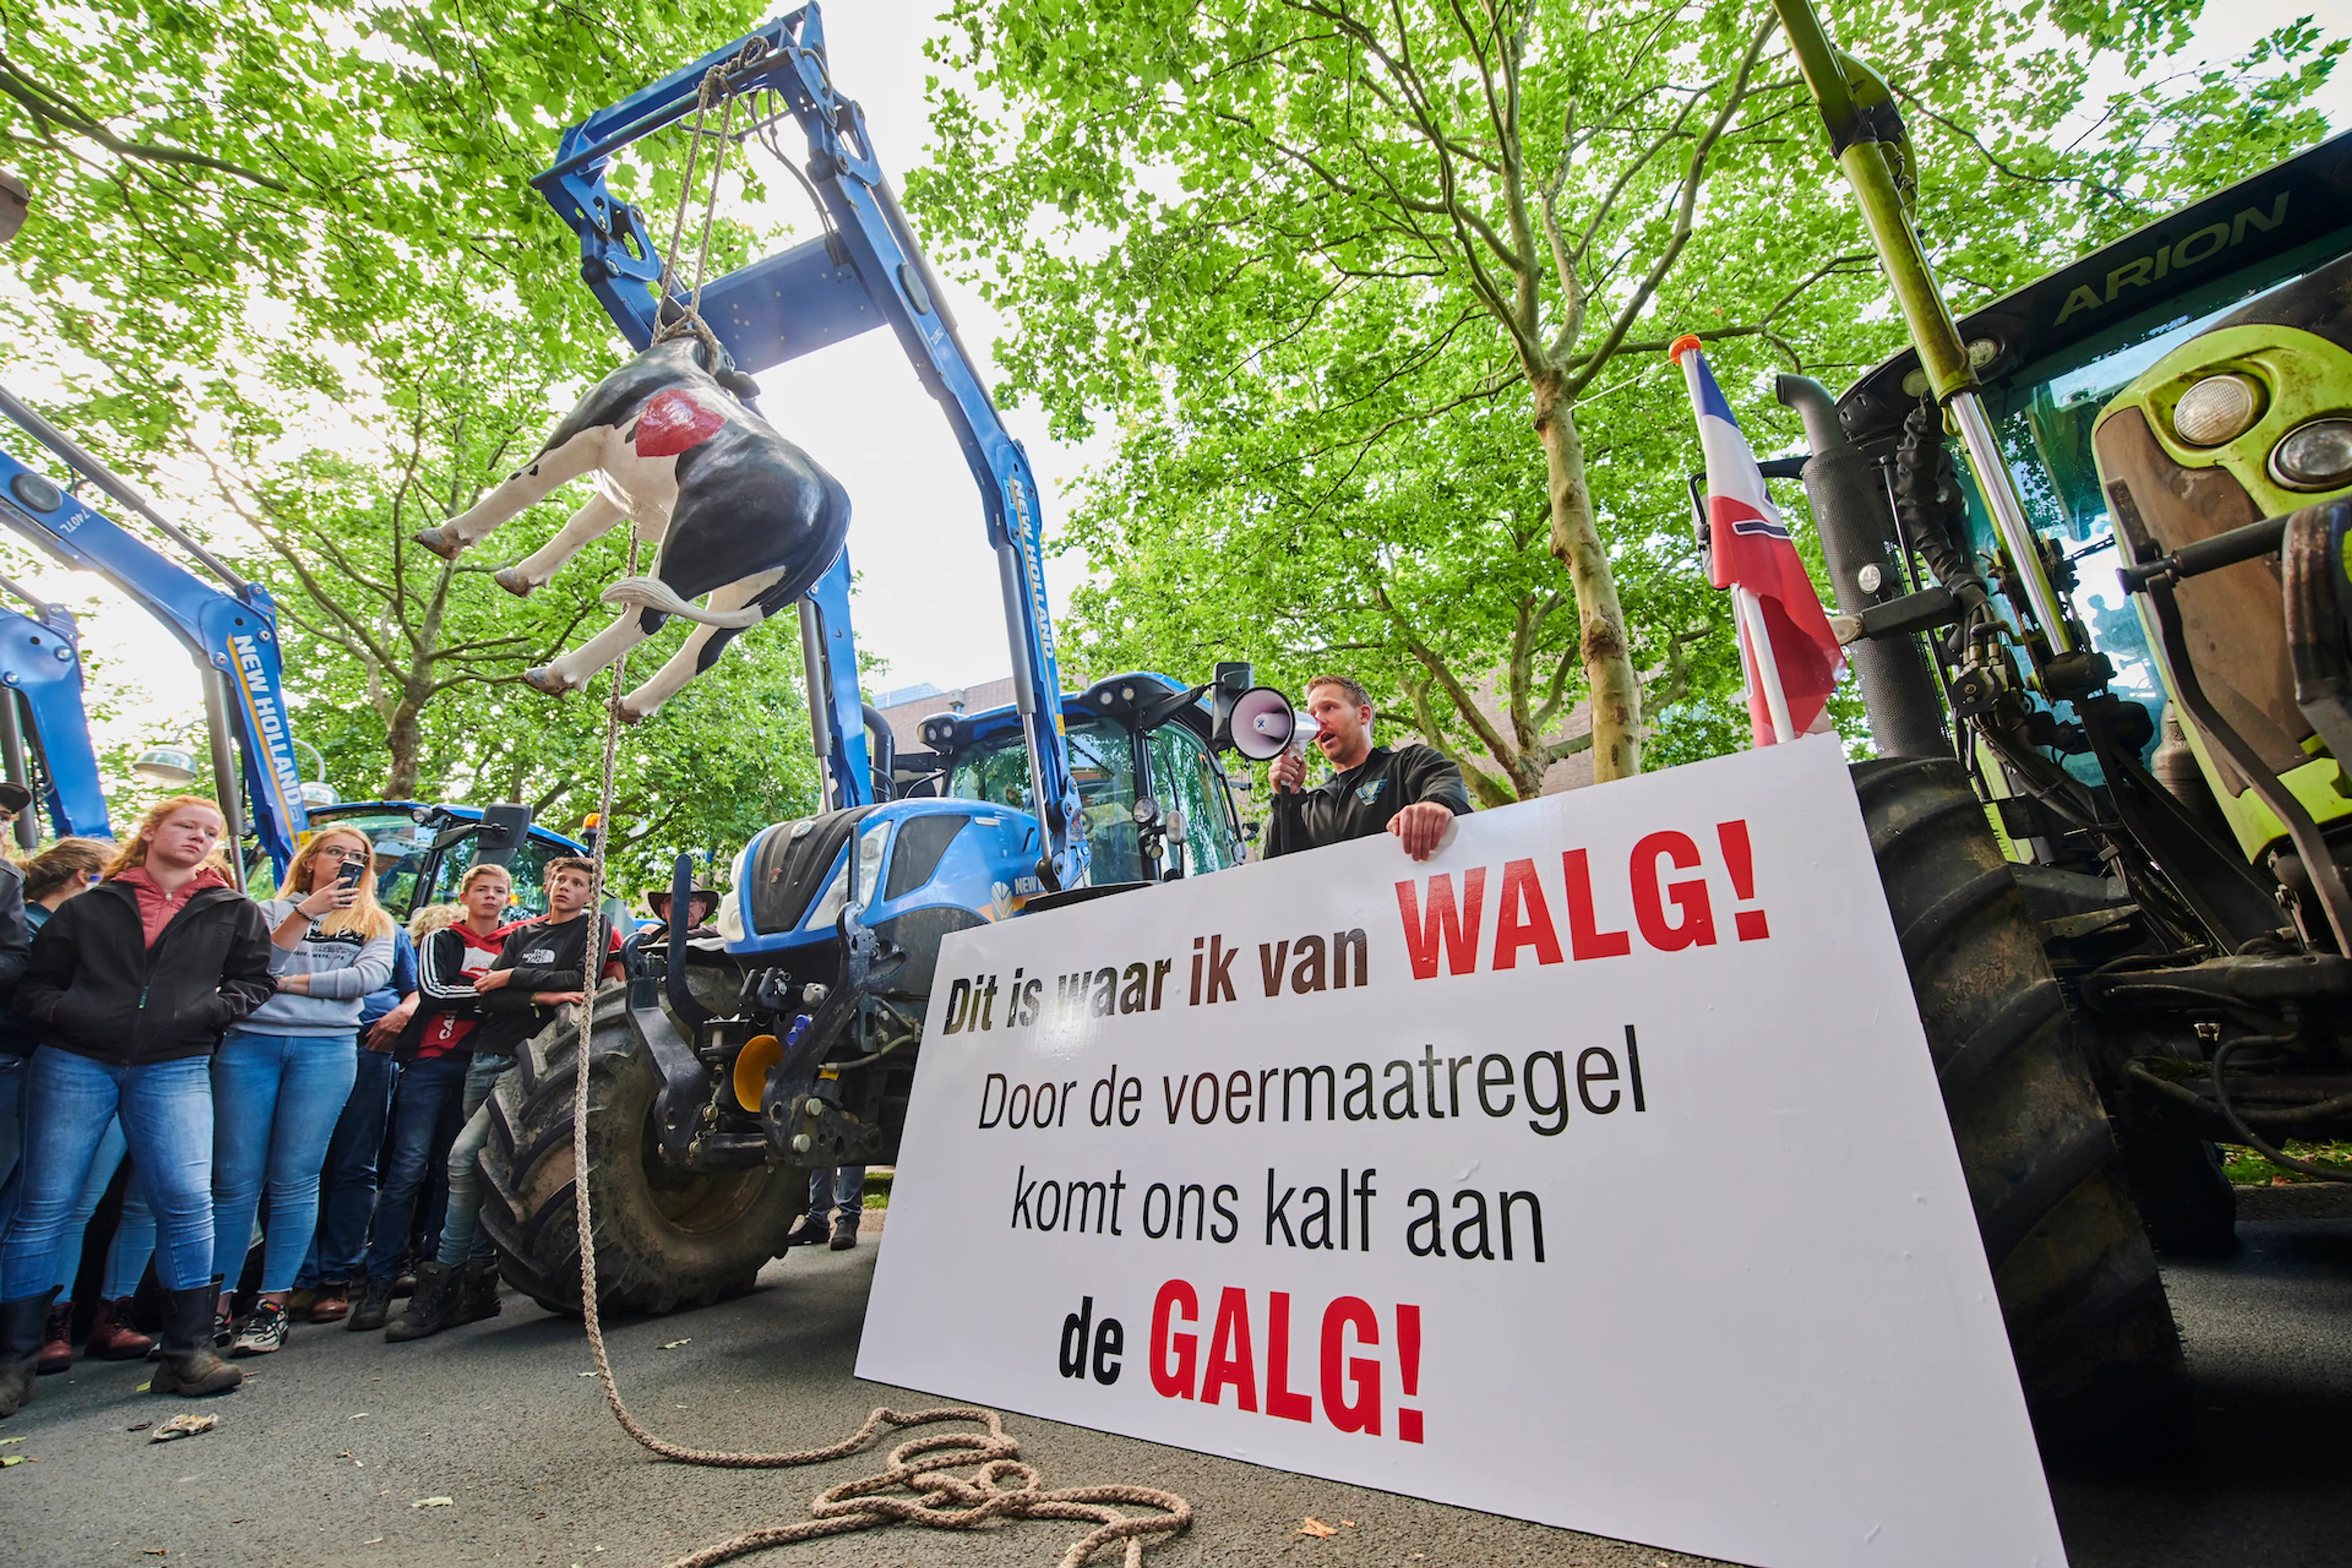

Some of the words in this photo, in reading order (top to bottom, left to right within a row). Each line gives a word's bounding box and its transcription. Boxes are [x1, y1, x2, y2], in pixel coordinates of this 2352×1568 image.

[59, 508, 91, 534] 740TL
[1013, 478, 1034, 541] NEW
[1025, 543, 1055, 659] HOLLAND
[233, 635, 270, 692] NEW
[254, 696, 303, 806] HOLLAND
[943, 973, 998, 1036] Dit
[1006, 967, 1042, 1028] is
[1058, 957, 1172, 1021] waar
[1189, 933, 1239, 1006] ik
[1259, 928, 1368, 998] van
[1394, 818, 1770, 981] WALG!
[1014, 876, 1038, 895] NEW
[978, 1072, 1077, 1129] Door
[1090, 1064, 1142, 1127] de
[1163, 1024, 1646, 1137] voermaatregel
[1011, 1165, 1126, 1237] komt
[1142, 1182, 1238, 1244] ons
[1265, 1167, 1377, 1252] kalf
[1406, 1188, 1545, 1263] aan
[1059, 1295, 1124, 1385] de
[1148, 1278, 1424, 1445] GALG!
